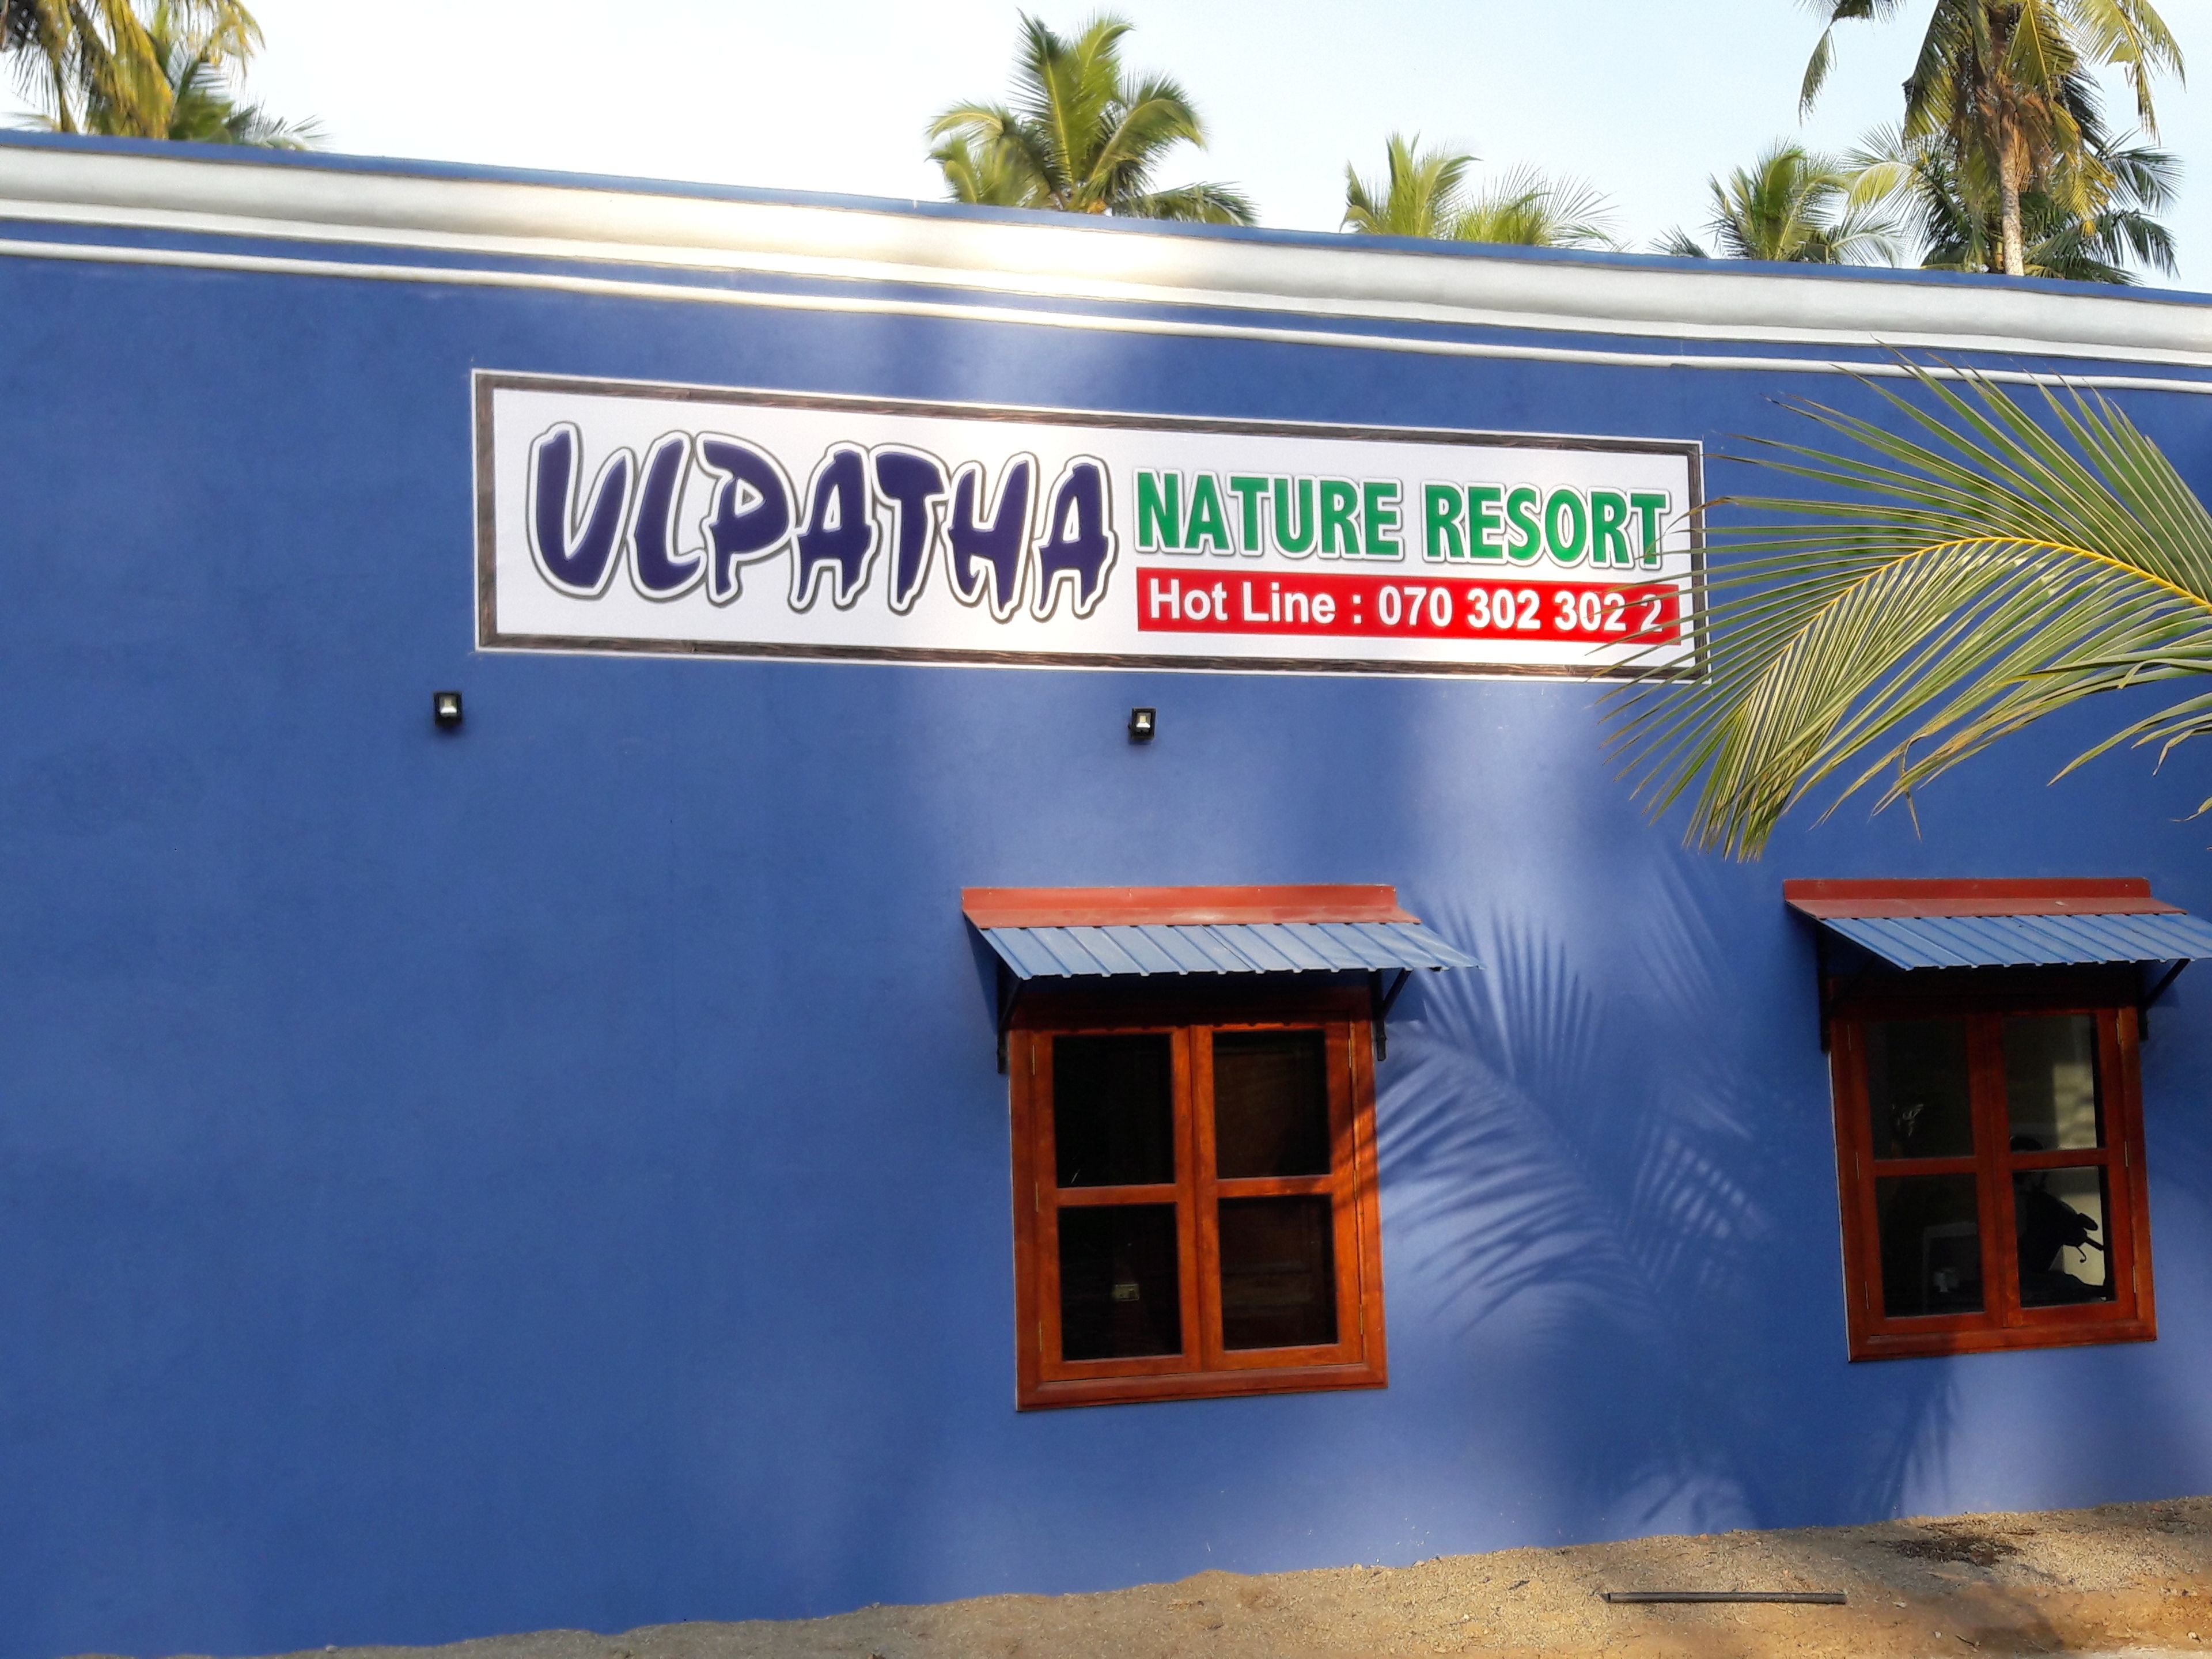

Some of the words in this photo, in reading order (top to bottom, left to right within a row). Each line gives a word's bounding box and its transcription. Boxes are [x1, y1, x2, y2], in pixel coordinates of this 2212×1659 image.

[532, 426, 1114, 619] ULPATHA
[1137, 470, 1400, 558] NATURE
[1423, 483, 1666, 566] RESORT
[1149, 578, 1228, 622] Hot
[1242, 581, 1336, 624] Line
[1352, 594, 1362, 624] :
[1378, 586, 1453, 627] 070
[1466, 589, 1541, 630] 302
[1554, 590, 1627, 631] 302
[1640, 594, 1664, 632] 2
